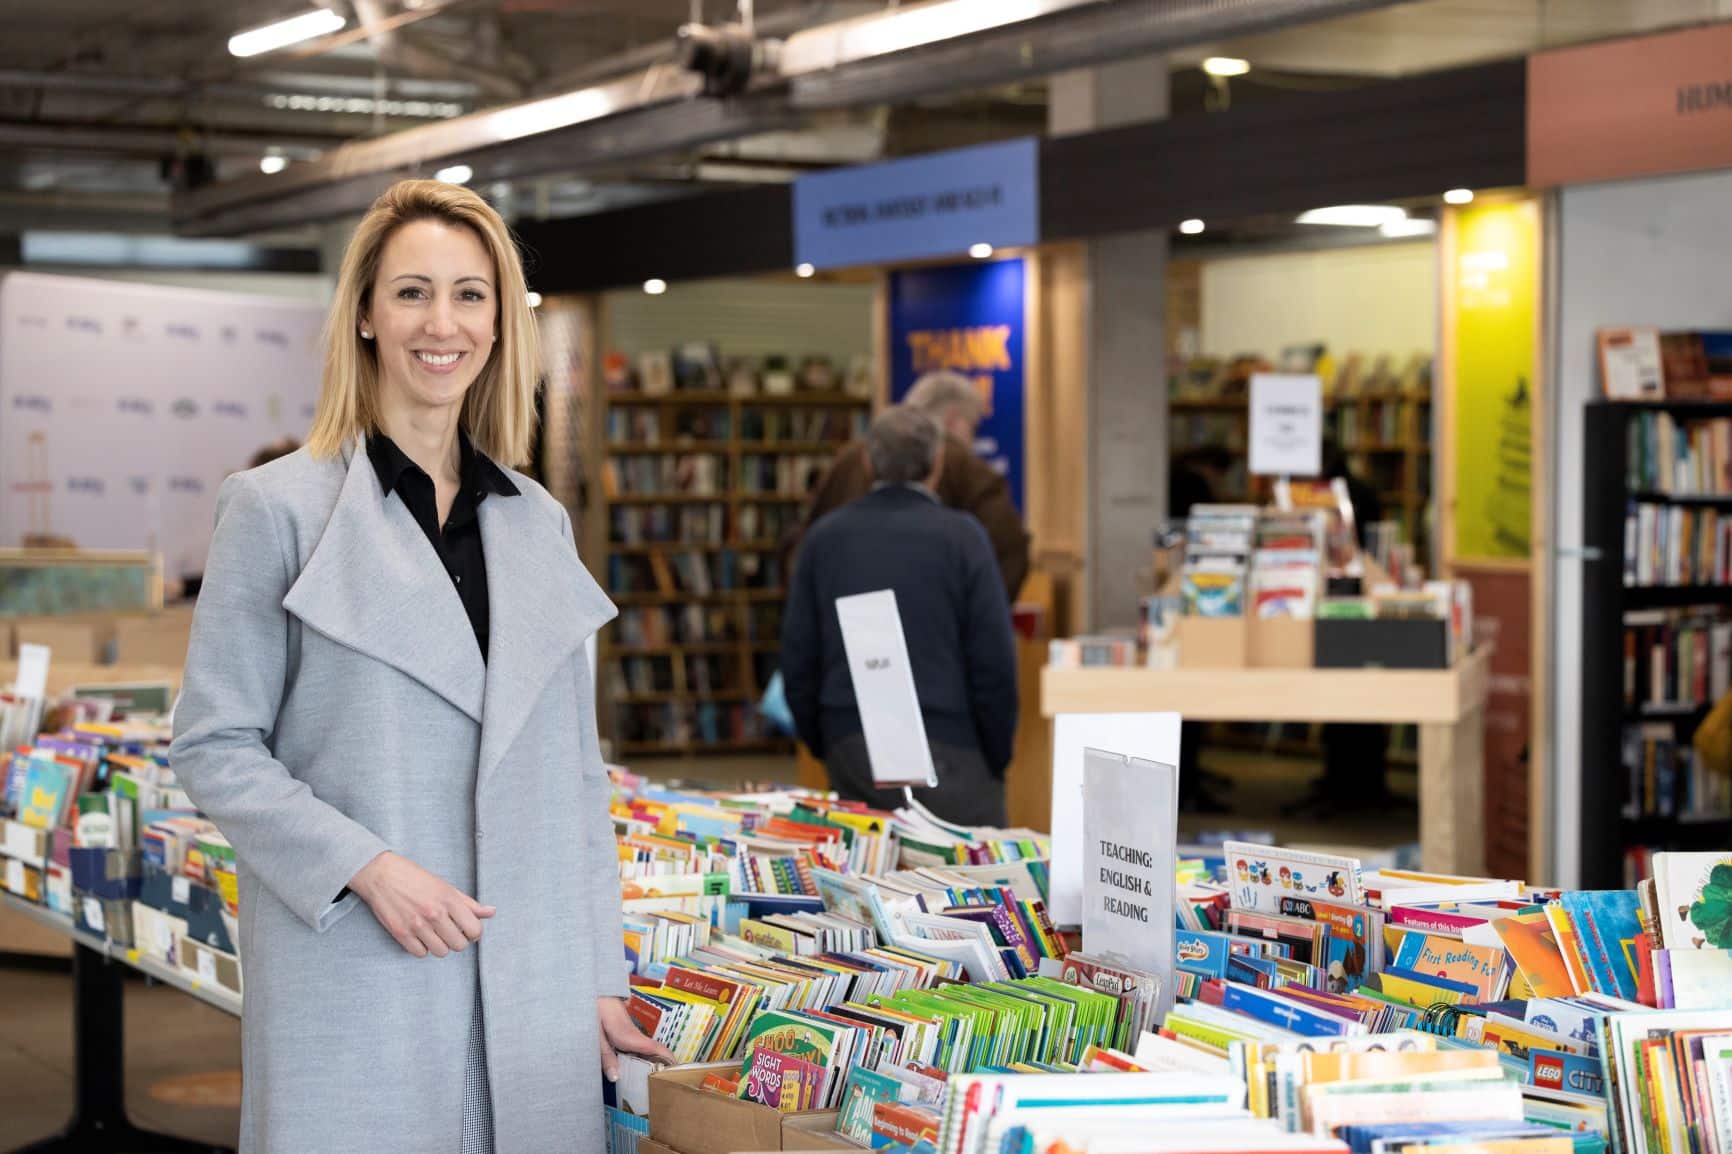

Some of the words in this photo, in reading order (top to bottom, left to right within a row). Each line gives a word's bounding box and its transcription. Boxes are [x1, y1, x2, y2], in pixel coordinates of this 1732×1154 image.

[907, 324, 1012, 372] THANK
[1100, 840, 1152, 868] TEACHING:
[1100, 867, 1141, 893] ENGLISH
[1144, 880, 1152, 896] &
[1104, 896, 1148, 922] READING
[1294, 902, 1311, 914] ABC
[1356, 923, 1362, 937] 2
[1404, 917, 1431, 928] Features
[1431, 921, 1438, 929] of
[1438, 923, 1450, 931] this
[1423, 948, 1441, 965] First
[1445, 949, 1479, 970] Reading
[1480, 962, 1496, 977] Fun
[756, 1053, 782, 1072] SIGHT
[1536, 1064, 1561, 1080] LEGO
[752, 1065, 781, 1088] WORDS
